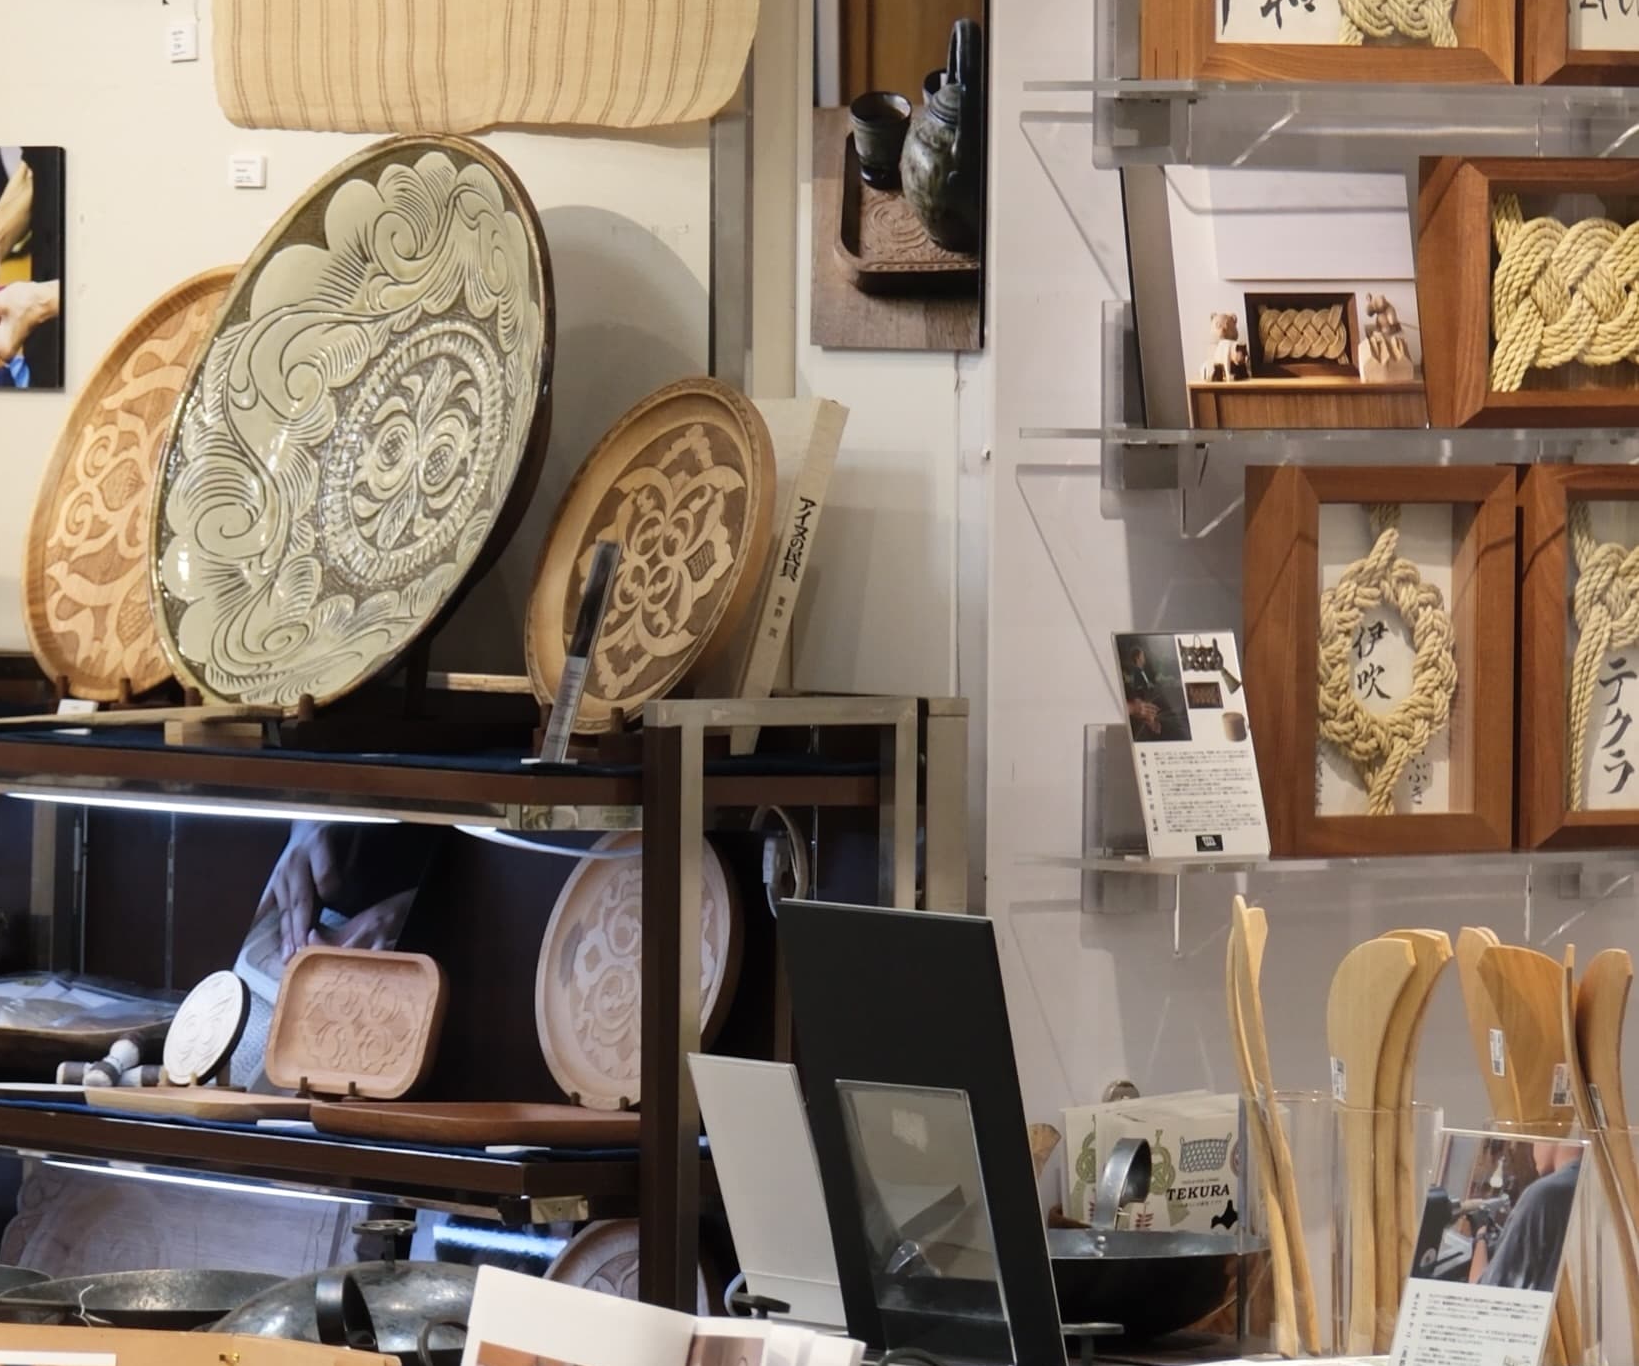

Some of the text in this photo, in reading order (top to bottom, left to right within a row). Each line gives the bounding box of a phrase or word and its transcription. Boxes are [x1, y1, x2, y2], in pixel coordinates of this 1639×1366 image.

[779, 496, 817, 583] アイヌの民具
[1598, 656, 1639, 795] テクラ
[1165, 1183, 1230, 1202] TEKURA
